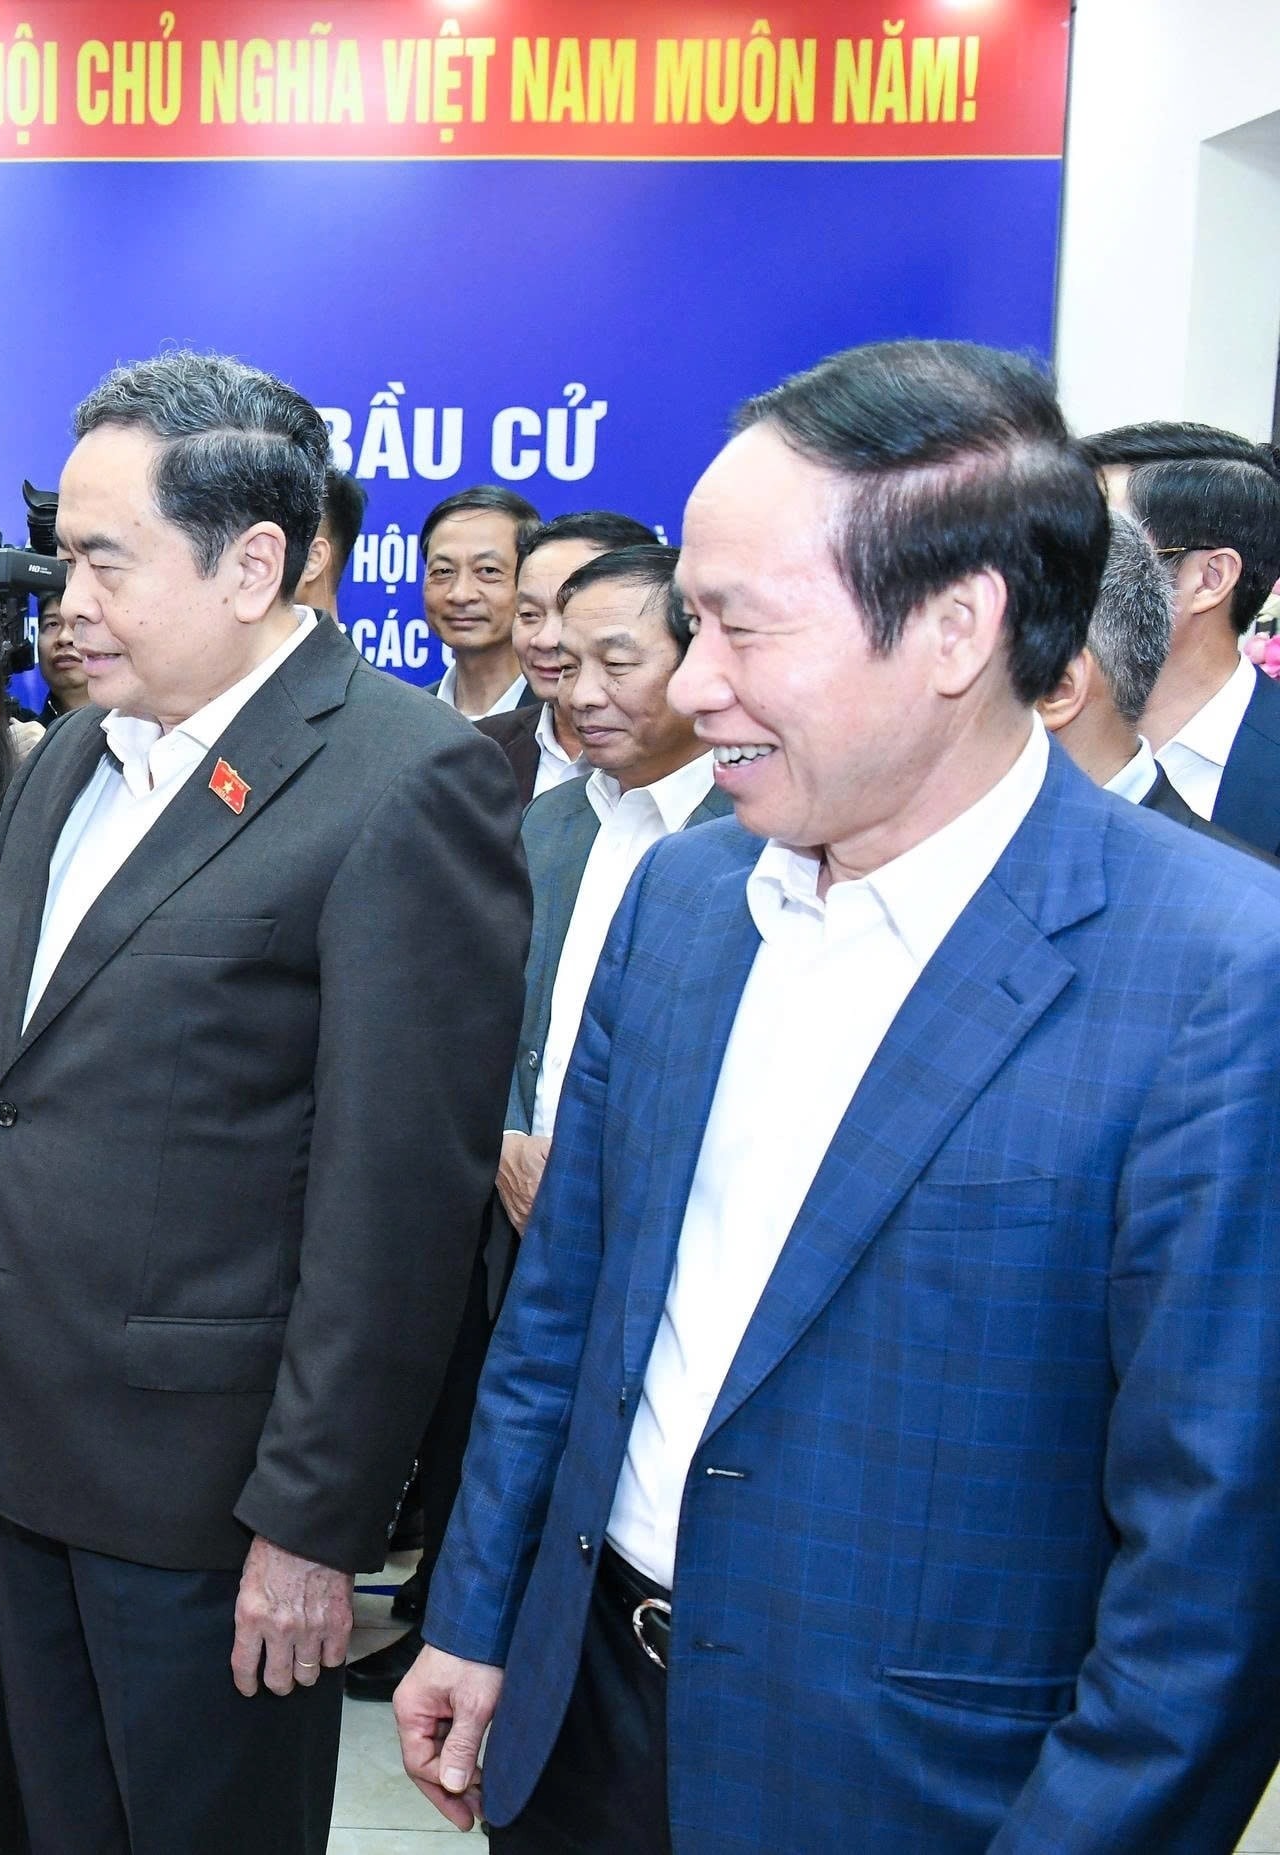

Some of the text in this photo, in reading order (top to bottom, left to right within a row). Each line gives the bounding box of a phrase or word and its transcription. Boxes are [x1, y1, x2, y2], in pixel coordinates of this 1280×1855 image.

[76, 11, 182, 126] CHỦ
[200, 21, 365, 125] NGHĨA
[382, 18, 496, 144] VIỆT
[510, 36, 638, 125] NAM
[652, 18, 817, 125] MUÔN
[832, 18, 981, 125] NĂM!
[314, 381, 608, 482] BẦU CỬ
[352, 523, 419, 594] HỘI
[352, 609, 430, 669] CÁC
